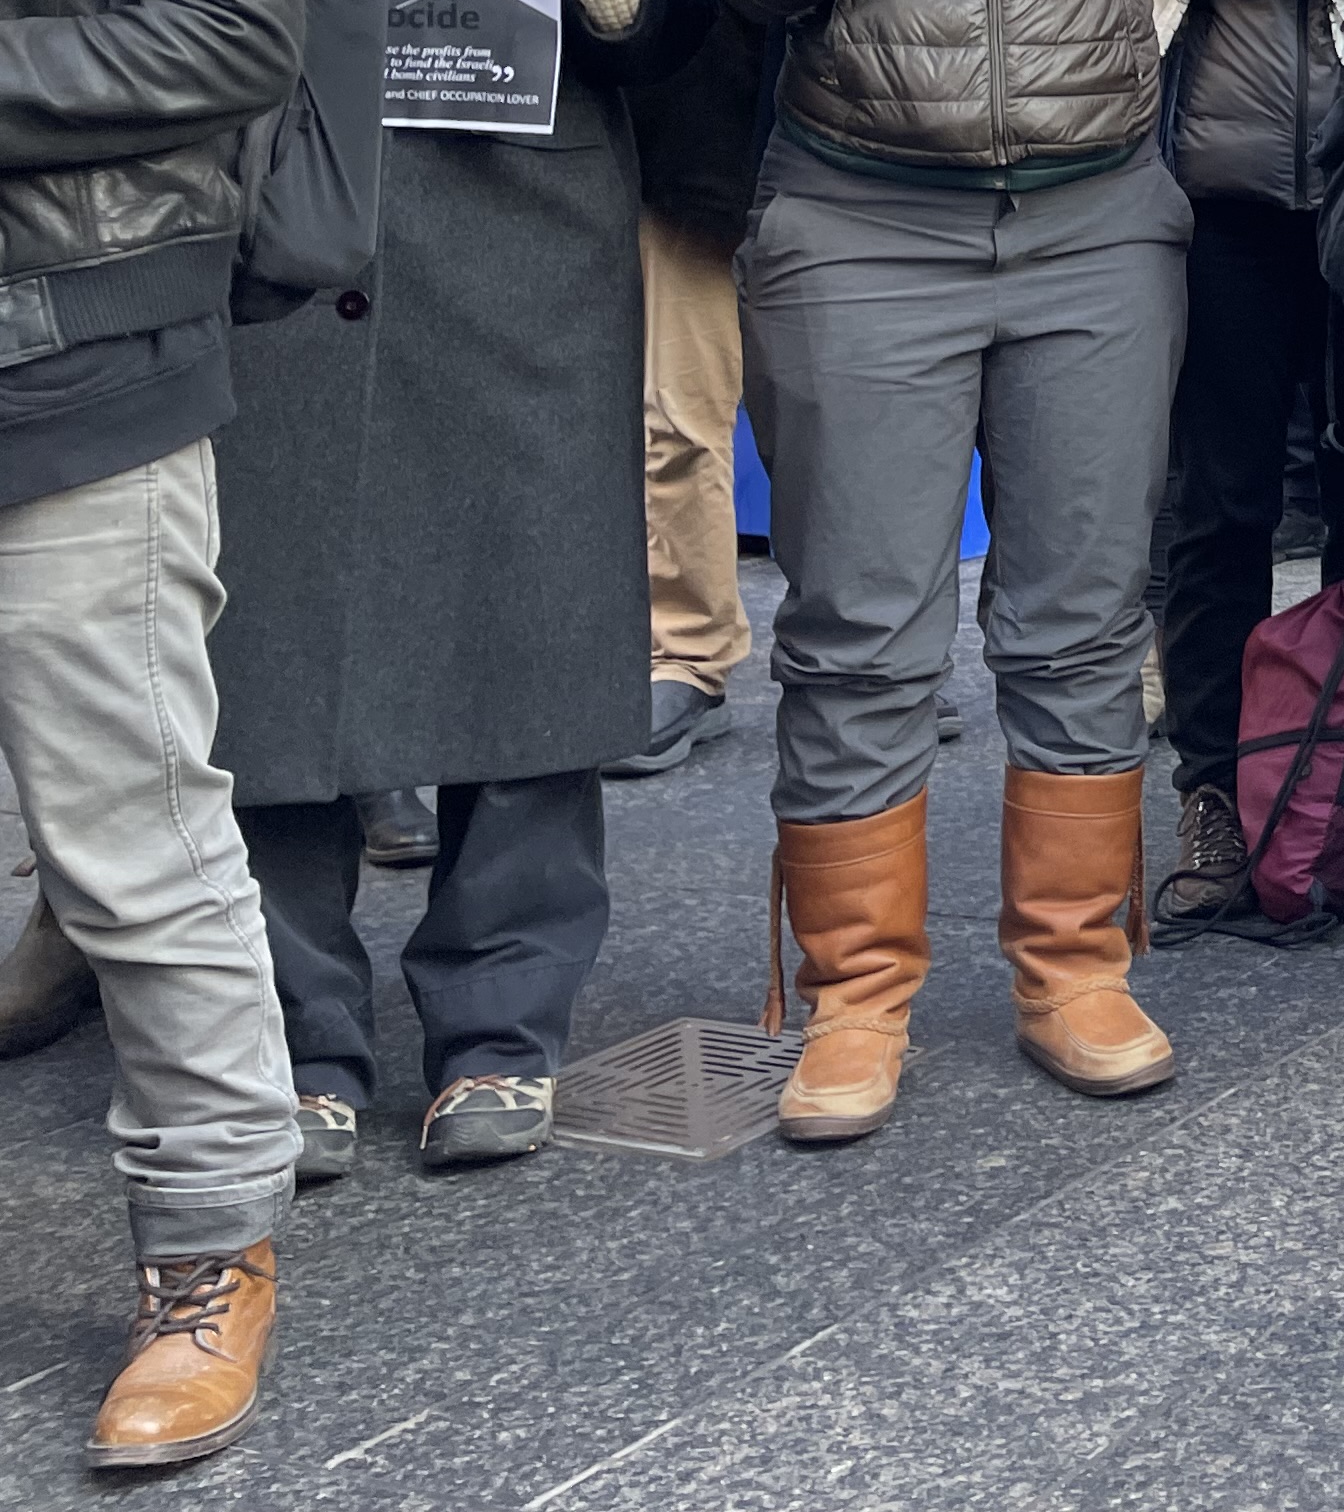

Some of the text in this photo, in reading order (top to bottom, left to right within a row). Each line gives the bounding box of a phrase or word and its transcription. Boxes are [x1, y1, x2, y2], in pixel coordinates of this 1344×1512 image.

[387, 1, 480, 30] ocide
[384, 43, 491, 60] se the profits from
[390, 55, 494, 71] to fund the Israeli
[390, 67, 424, 81] bomb
[425, 69, 476, 83] civilians
[384, 88, 540, 106] and CHIEF OCCUPATION LOVER
